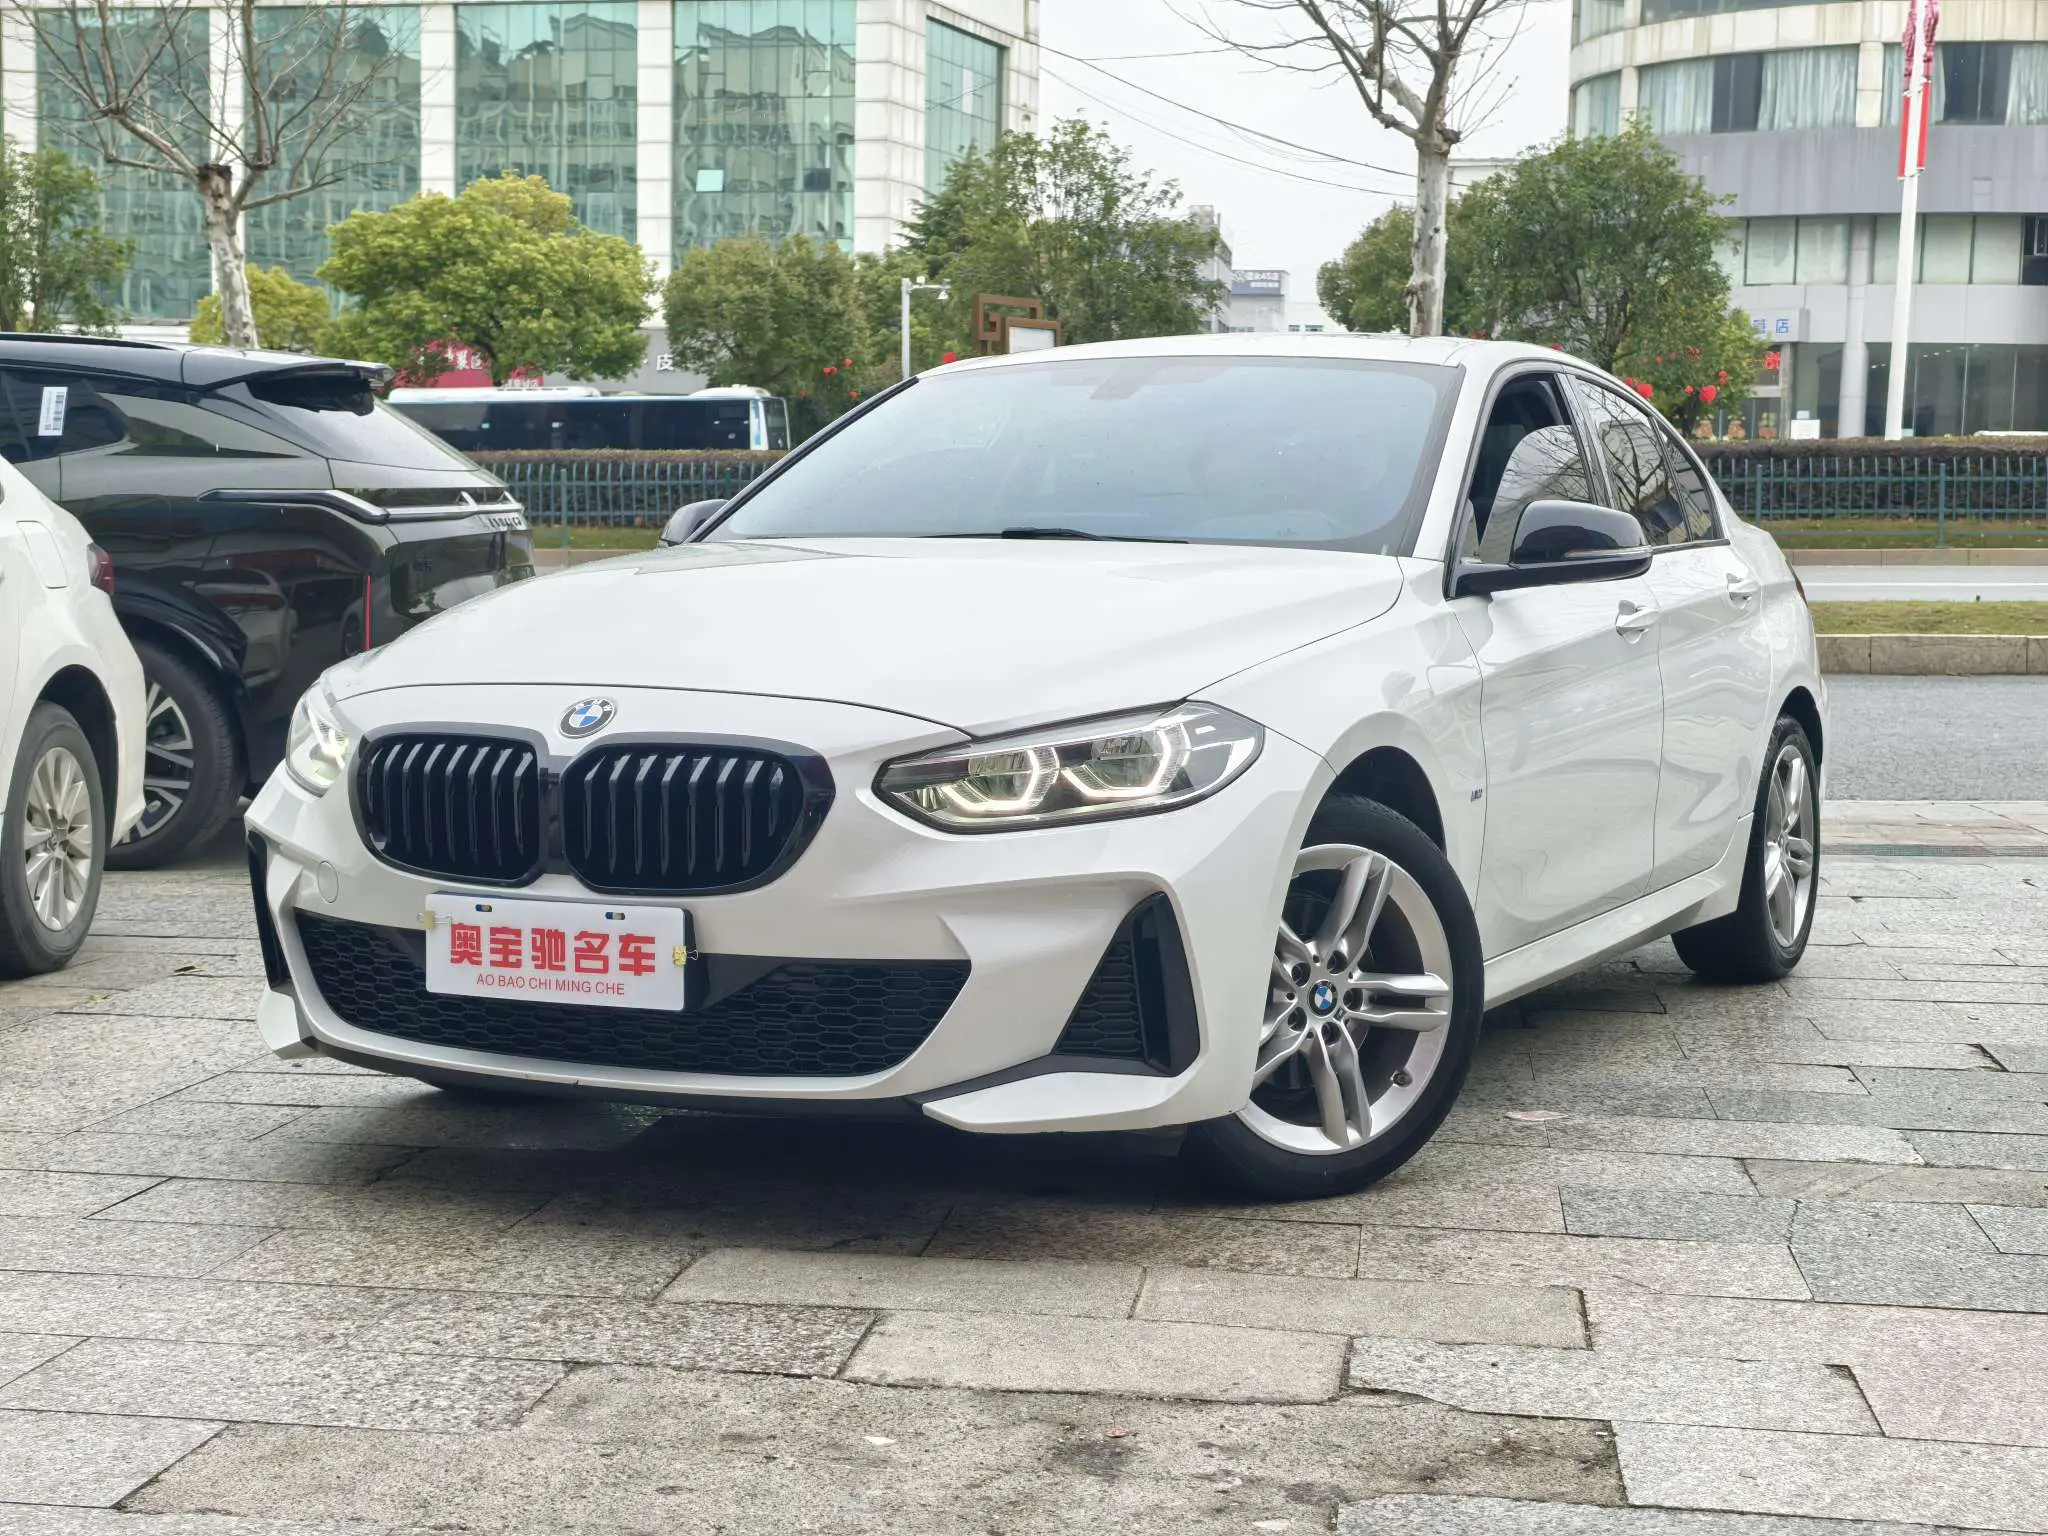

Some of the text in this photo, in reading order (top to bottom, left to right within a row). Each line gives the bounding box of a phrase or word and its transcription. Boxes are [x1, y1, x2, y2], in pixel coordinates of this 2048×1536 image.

[656, 354, 674, 371] 皮
[450, 922, 656, 977] 奥宝驰名车
[476, 973, 625, 995] AO BAO CHI MING CHE
